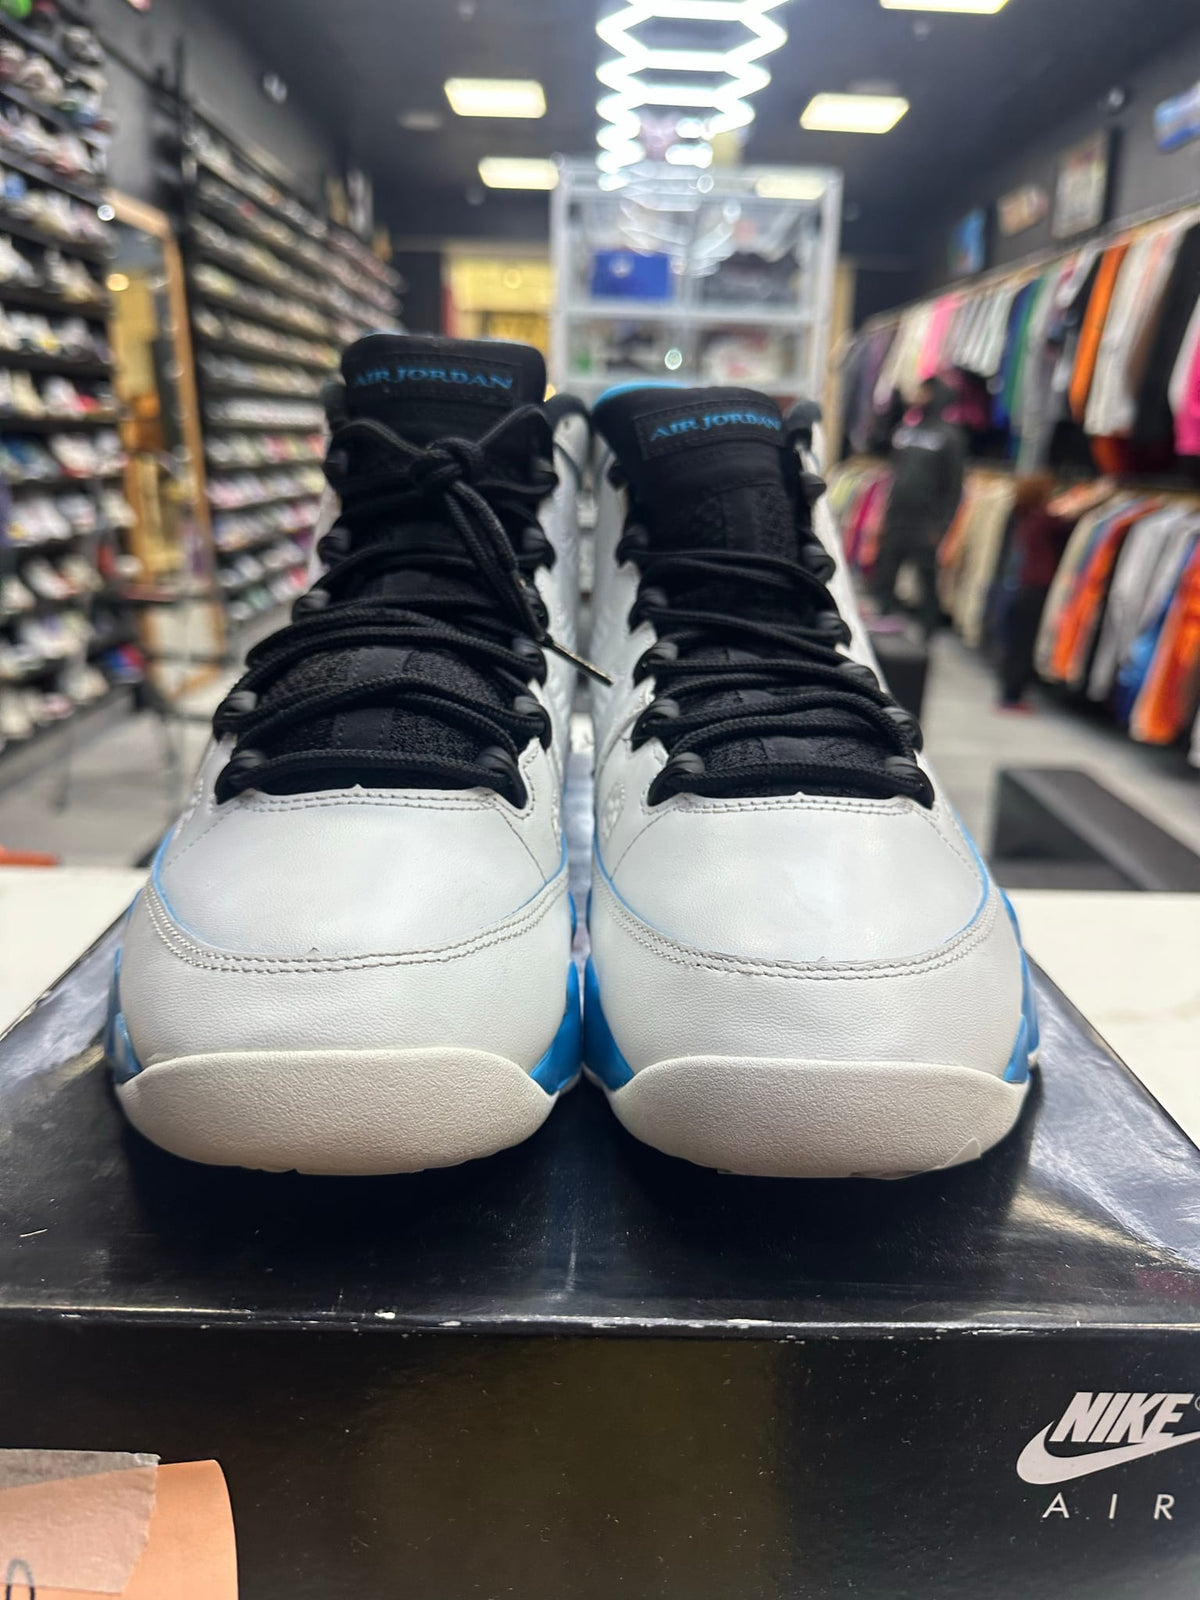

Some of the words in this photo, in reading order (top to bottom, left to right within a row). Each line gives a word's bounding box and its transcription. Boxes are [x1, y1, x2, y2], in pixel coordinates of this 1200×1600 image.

[353, 367, 391, 387] AIR
[394, 366, 514, 390] JORDAN
[650, 419, 700, 441] AIR
[700, 412, 783, 431] JORDAN
[1049, 1392, 1195, 1444] NIKE
[1042, 1492, 1175, 1520] AIR
